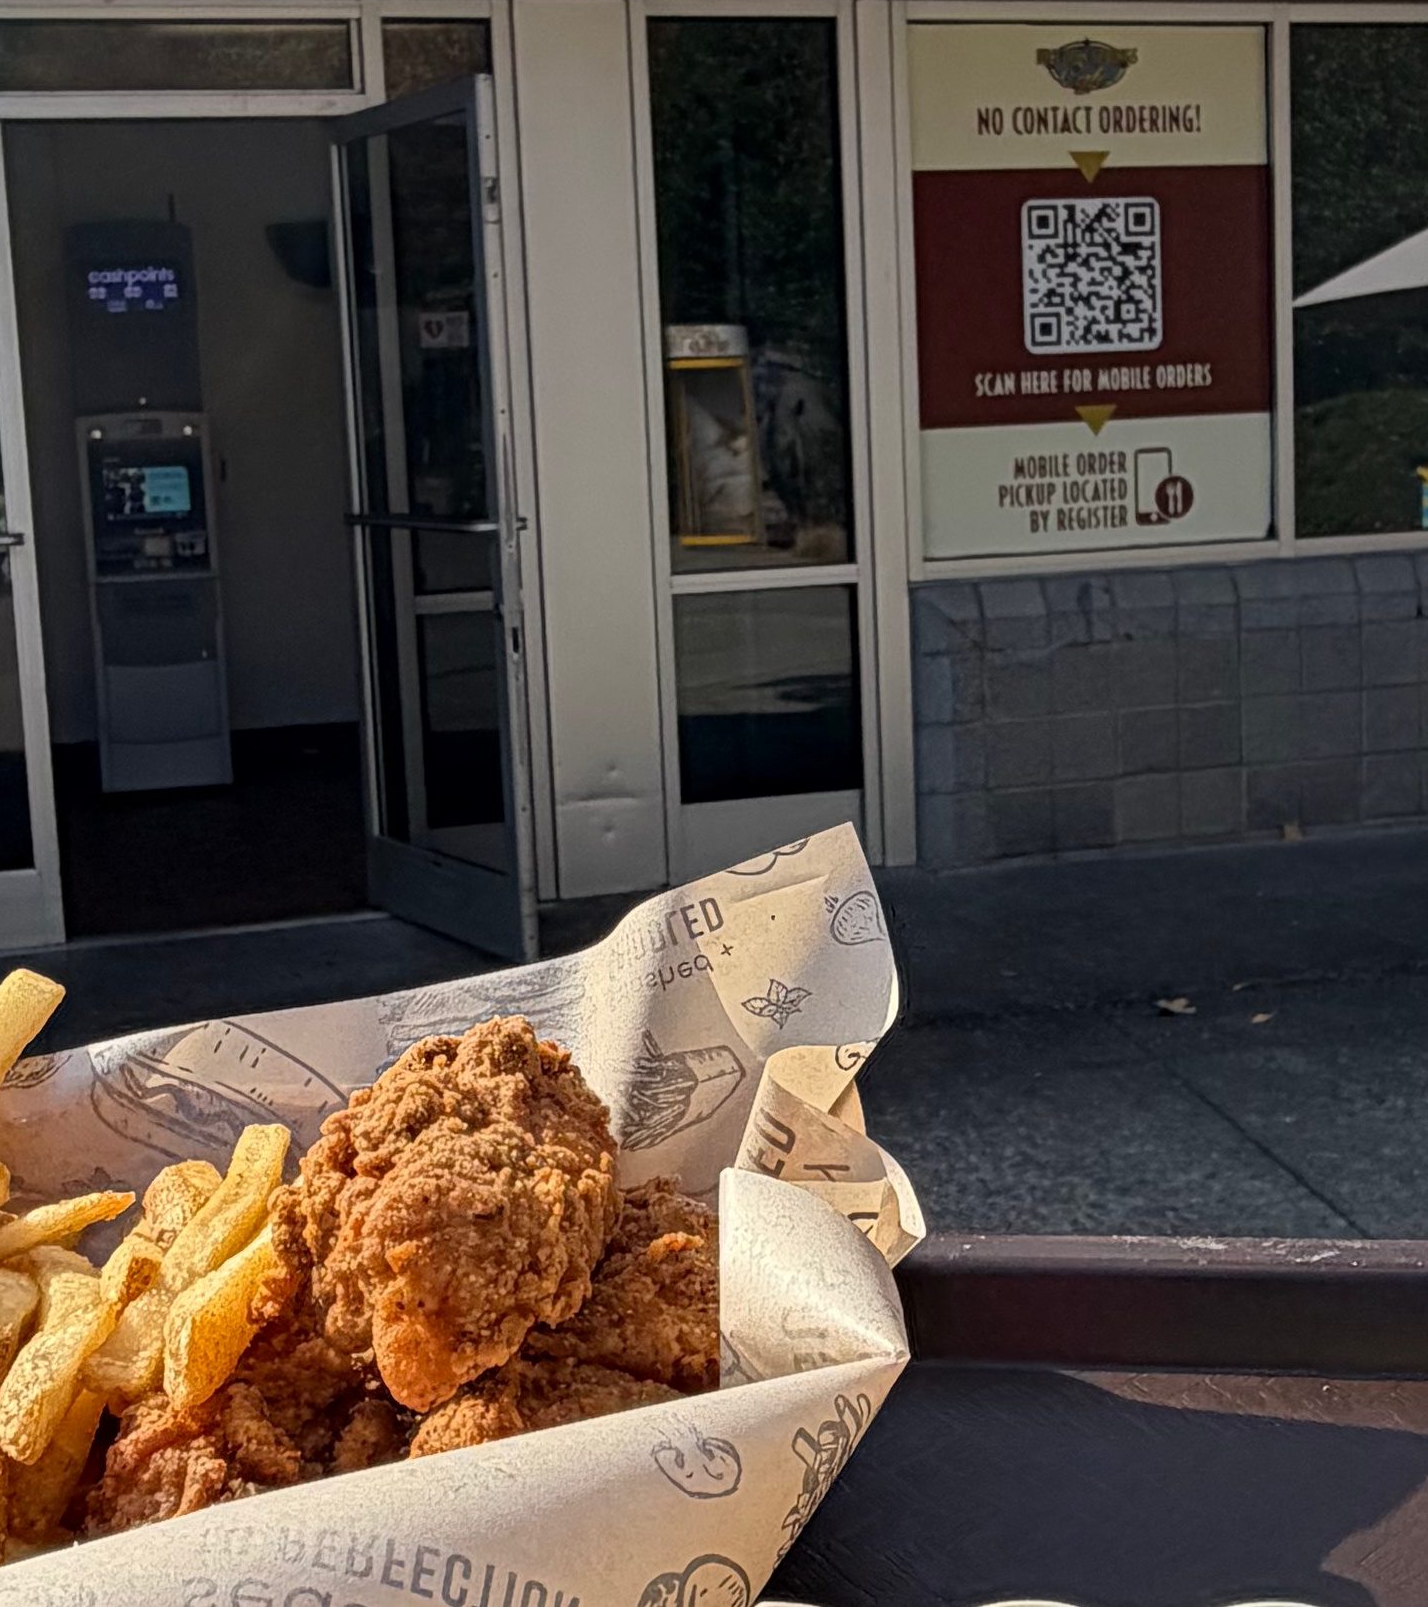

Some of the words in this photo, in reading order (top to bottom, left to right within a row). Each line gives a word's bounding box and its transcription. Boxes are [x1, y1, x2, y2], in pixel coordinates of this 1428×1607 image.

[976, 106, 1004, 136] NO
[1011, 105, 1093, 135] CONTACT
[1098, 103, 1202, 133] ORDERING!
[87, 266, 175, 287] cashpoints
[975, 372, 1016, 397] SCAN
[1021, 370, 1058, 395] HERE
[1063, 368, 1093, 393] FOR
[1097, 365, 1151, 391] MOBILE
[1155, 363, 1213, 389] ORDERS
[1013, 453, 1070, 480] MOBILE
[1076, 450, 1128, 476] ORDER
[998, 481, 1056, 508] PICKUP
[1062, 478, 1128, 505] LOCATED
[1030, 509, 1050, 533] BY
[1056, 505, 1128, 532] REGISTER
